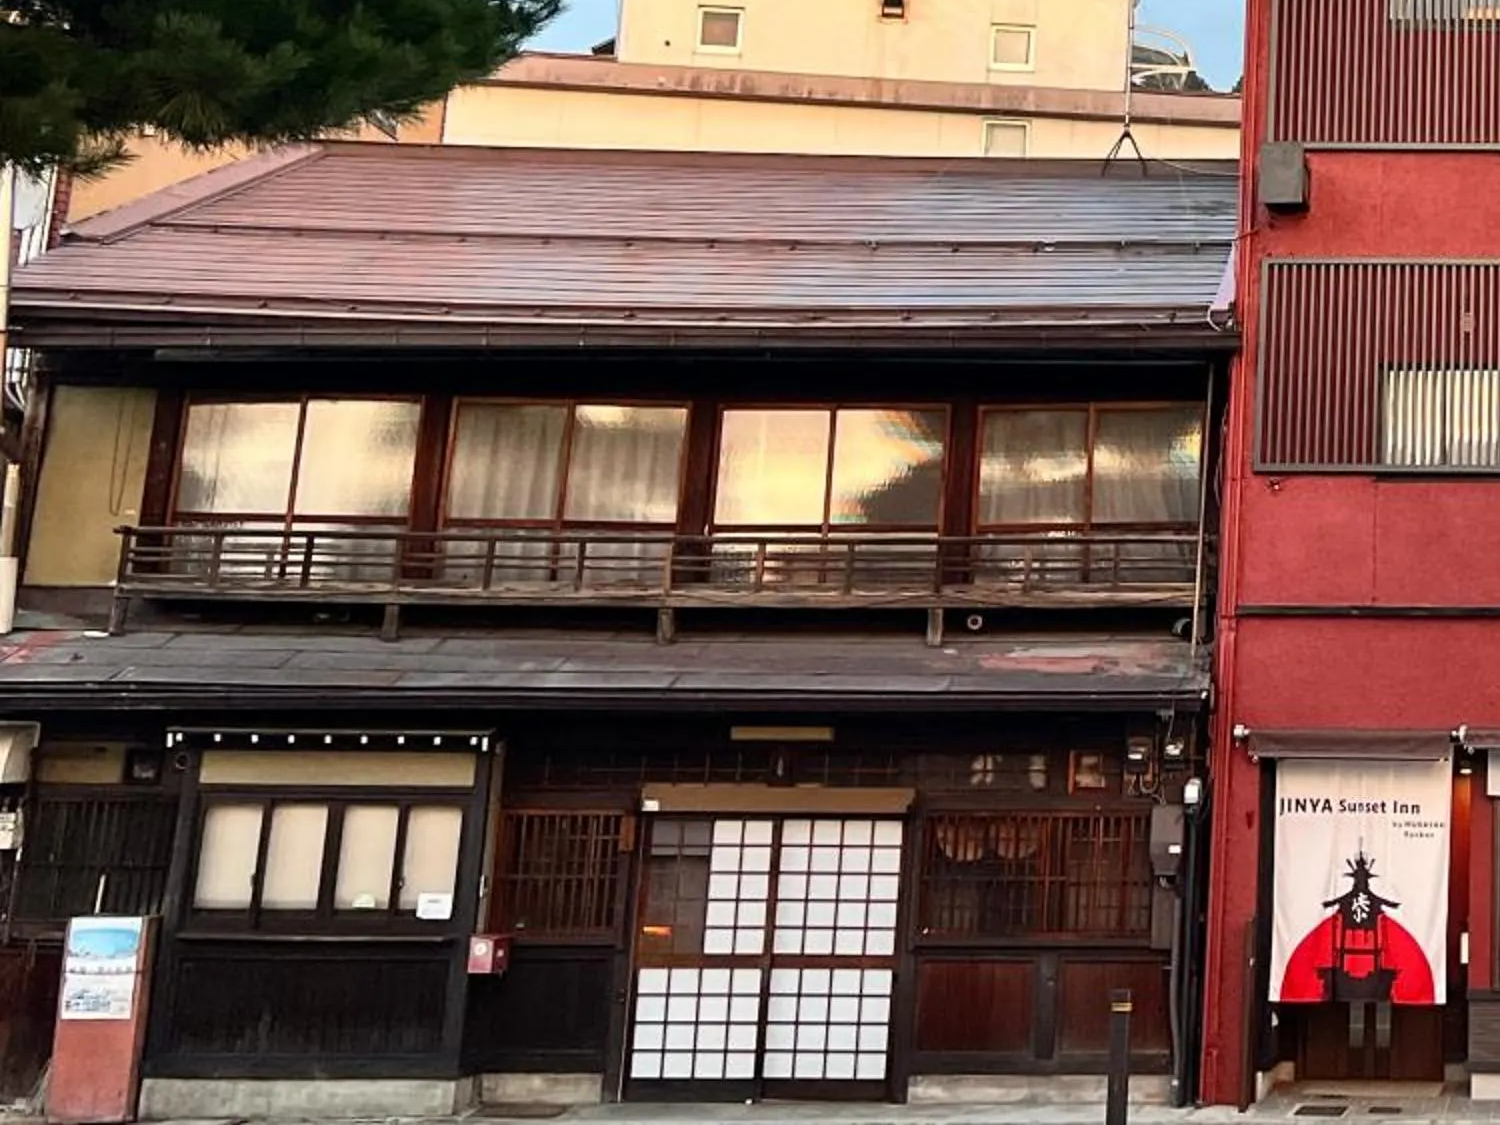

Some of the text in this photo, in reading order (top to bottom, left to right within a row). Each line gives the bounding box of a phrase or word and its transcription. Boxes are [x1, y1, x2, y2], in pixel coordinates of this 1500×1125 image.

[1279, 798, 1421, 816] JINYA Sunset Inn
